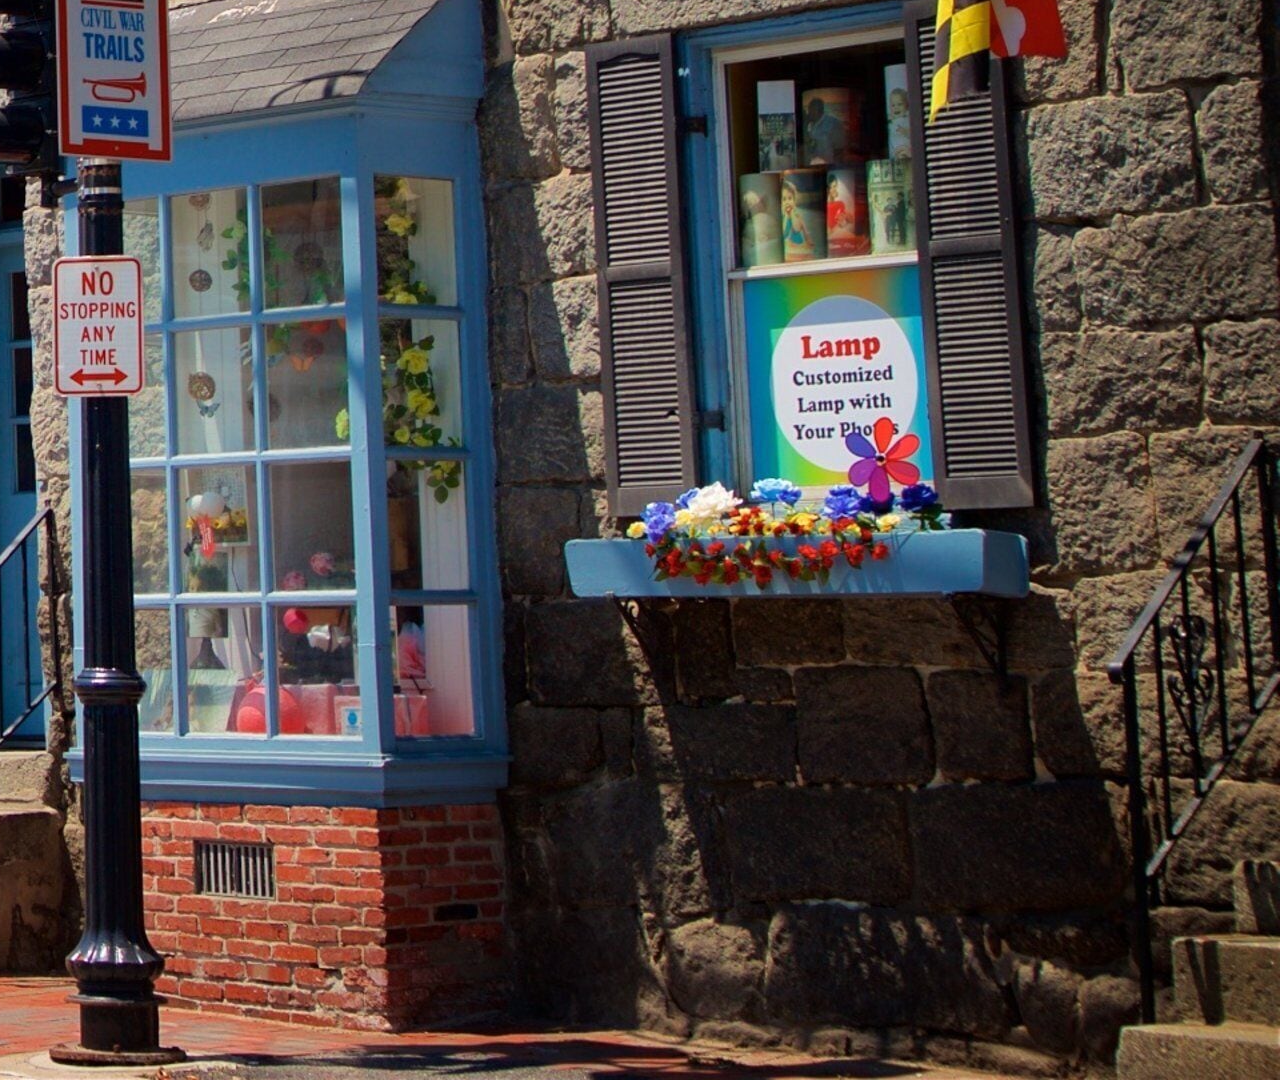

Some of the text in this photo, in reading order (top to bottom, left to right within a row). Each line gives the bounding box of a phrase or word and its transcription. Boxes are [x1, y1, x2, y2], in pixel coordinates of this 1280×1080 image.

[81, 7, 145, 32] CIVIL WAR
[83, 32, 145, 62] TRAILS
[82, 271, 114, 296] NO
[60, 301, 136, 320] STOPPING
[80, 326, 115, 342] ANY
[80, 349, 117, 365] TIME
[801, 336, 881, 360] Lamp
[792, 365, 893, 386] Customized
[797, 393, 892, 415] Lamp with
[793, 421, 899, 440] Your Phos
